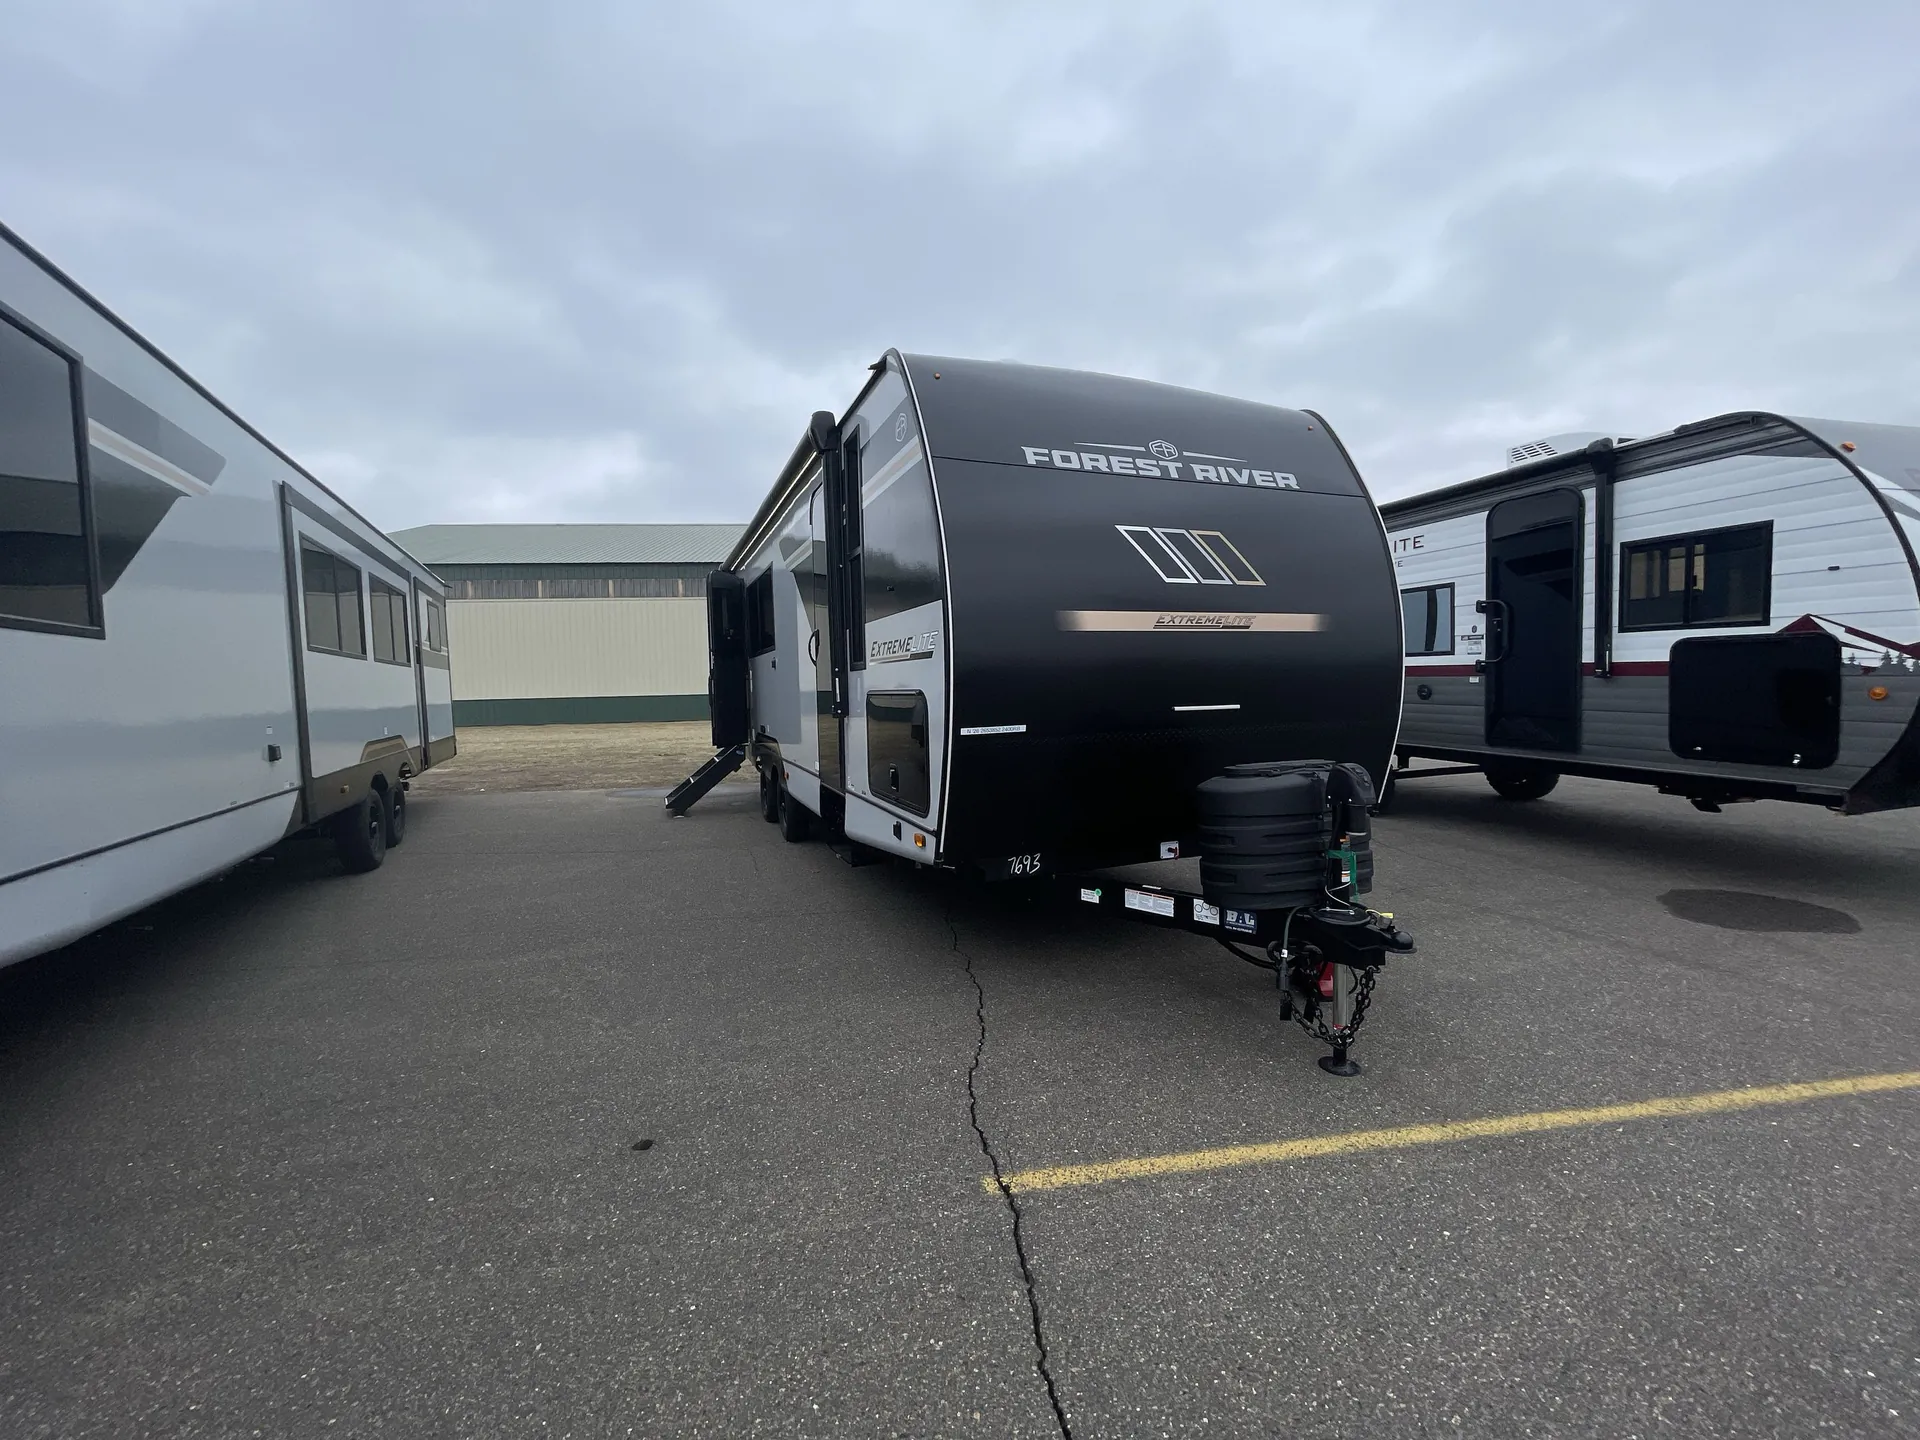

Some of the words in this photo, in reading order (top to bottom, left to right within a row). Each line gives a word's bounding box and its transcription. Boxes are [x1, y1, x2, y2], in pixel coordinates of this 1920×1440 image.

[1020, 446, 1183, 479] FOREST
[1189, 463, 1301, 489] RIVER
[1393, 535, 1425, 553] ITE
[1007, 853, 1041, 875] 7693
